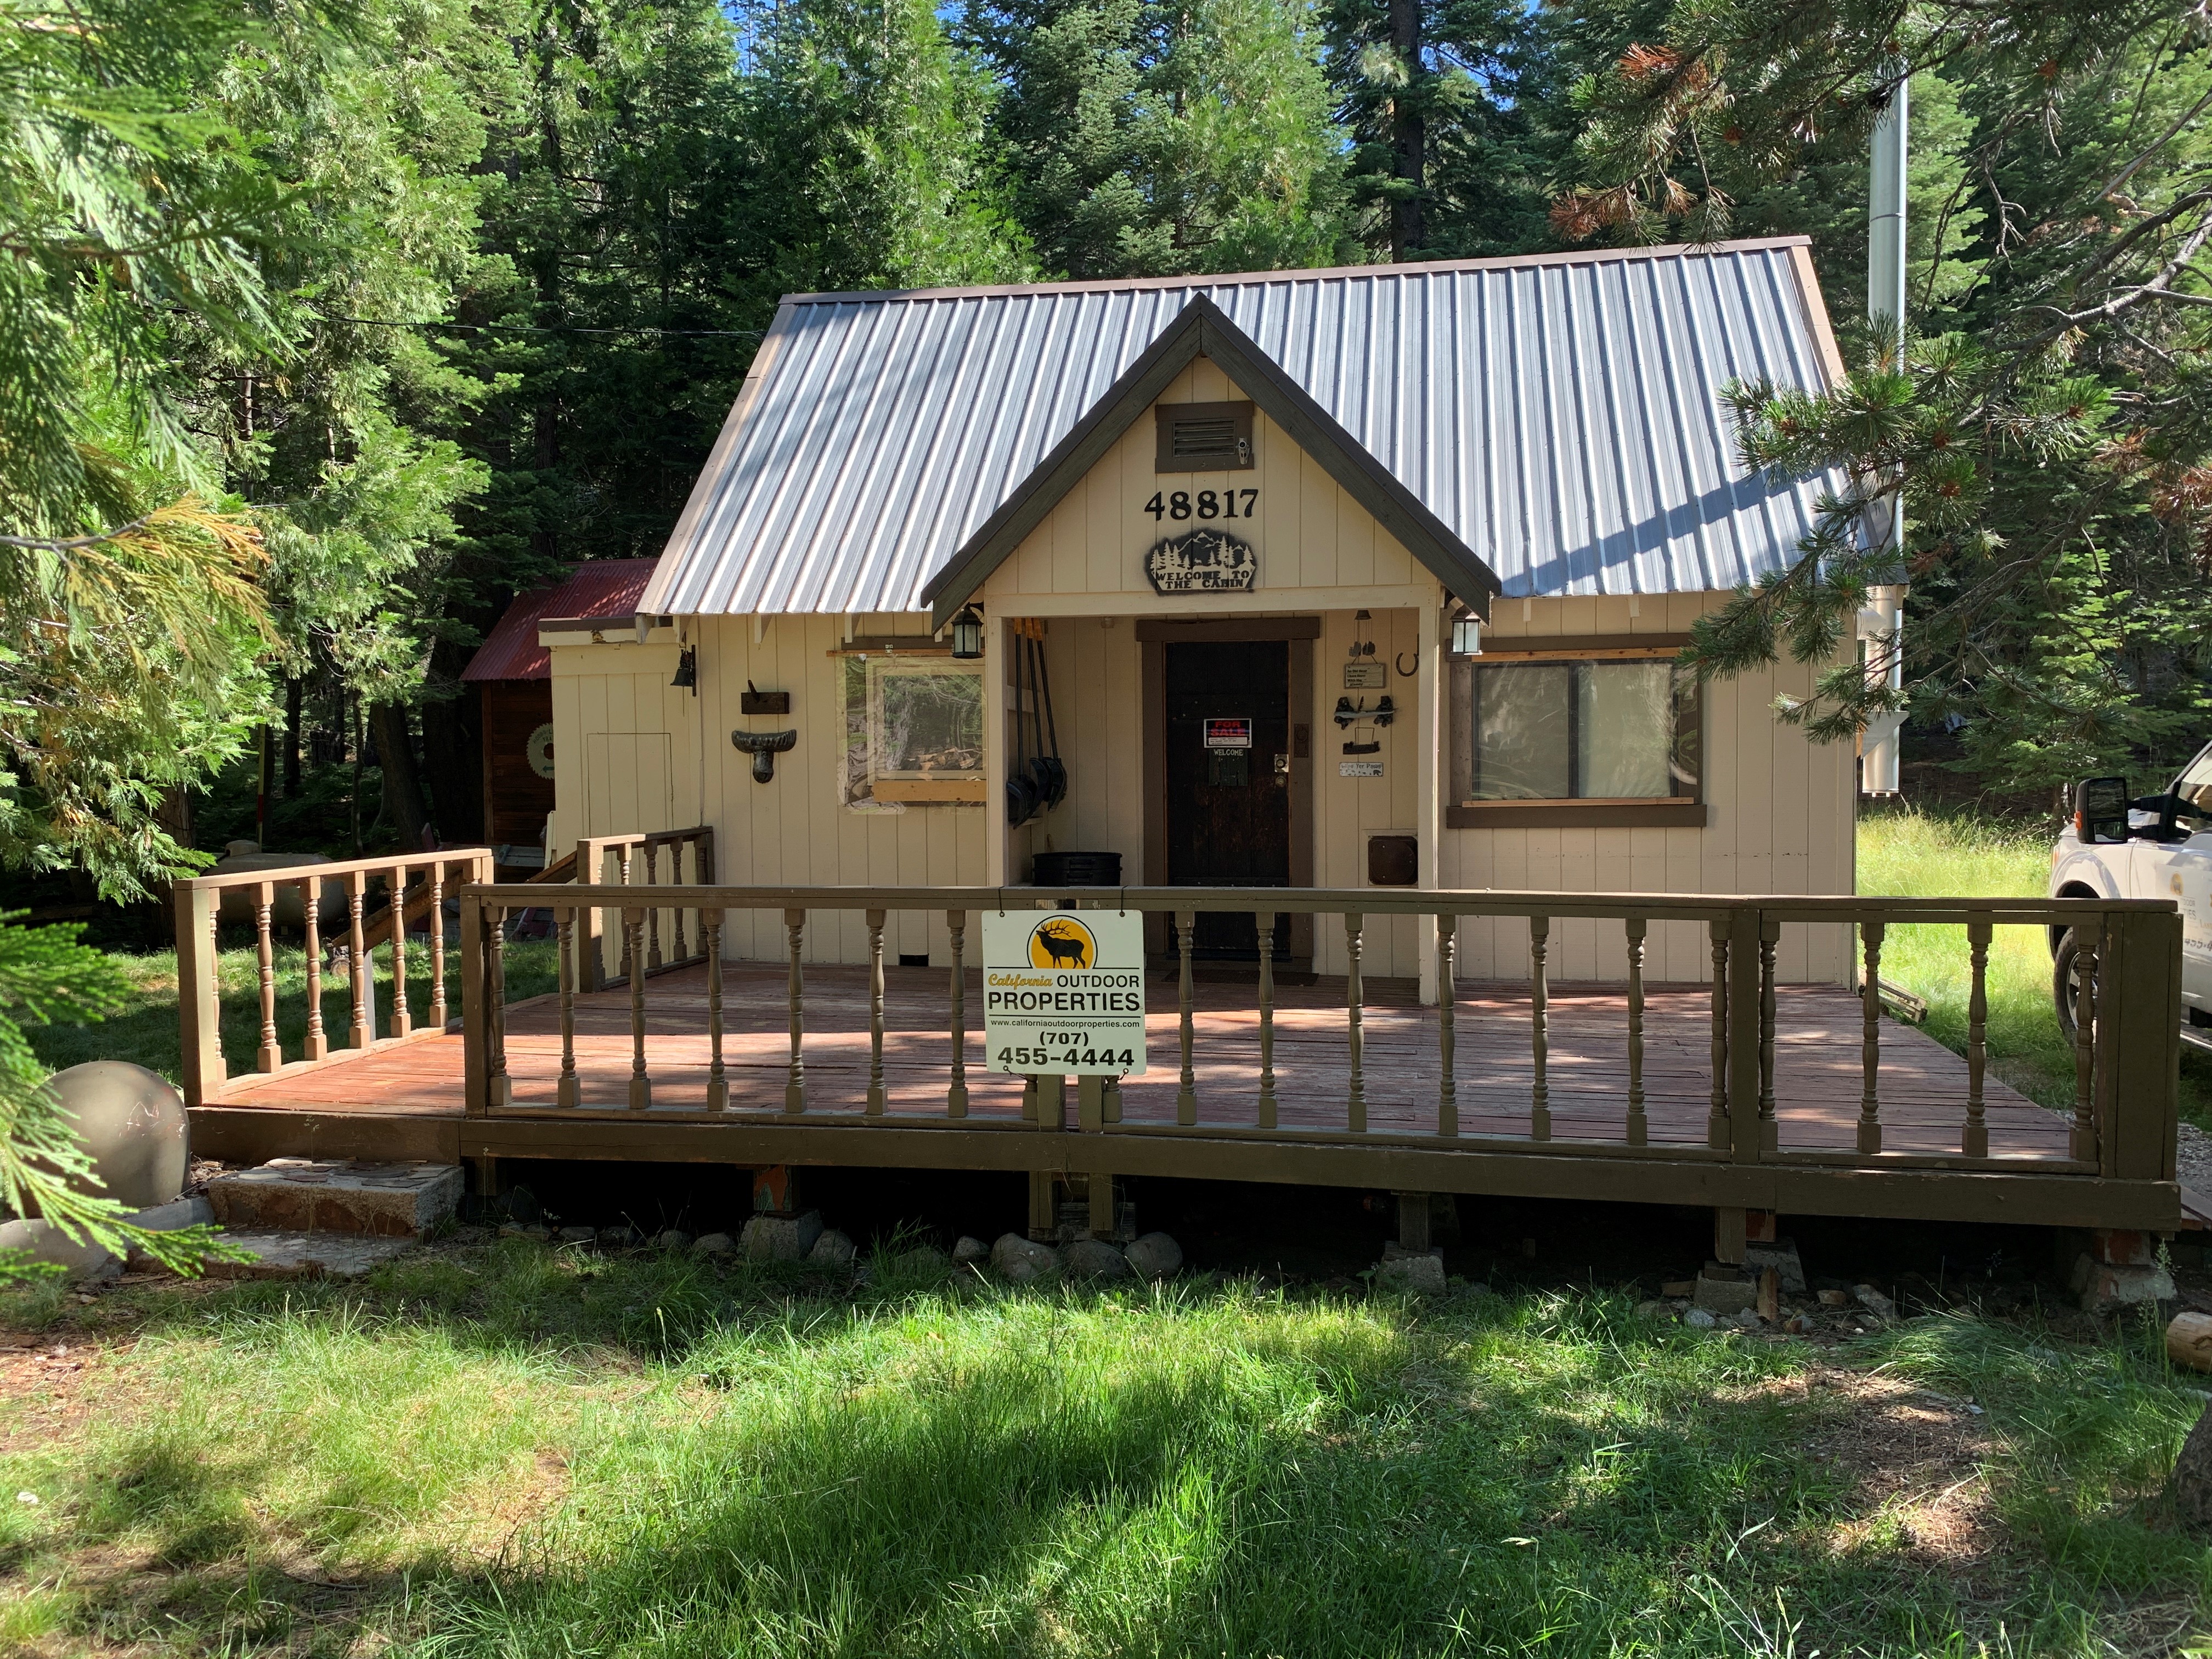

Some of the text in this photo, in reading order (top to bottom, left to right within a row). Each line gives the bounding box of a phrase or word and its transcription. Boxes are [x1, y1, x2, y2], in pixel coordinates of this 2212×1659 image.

[1144, 489, 1259, 521] 48817
[1156, 570, 1250, 581] WELCOME TO
[1165, 579, 1243, 589] THE CABIN
[1210, 728, 1245, 736] SALE
[988, 973, 1139, 990] California OUTDOOR
[989, 991, 1140, 1011] PROPERTIES
[991, 1019, 1140, 1029] www.californiaoutdoorproperties.com
[1040, 1031, 1089, 1047] (707)
[997, 1047, 1135, 1066] 455-4444
